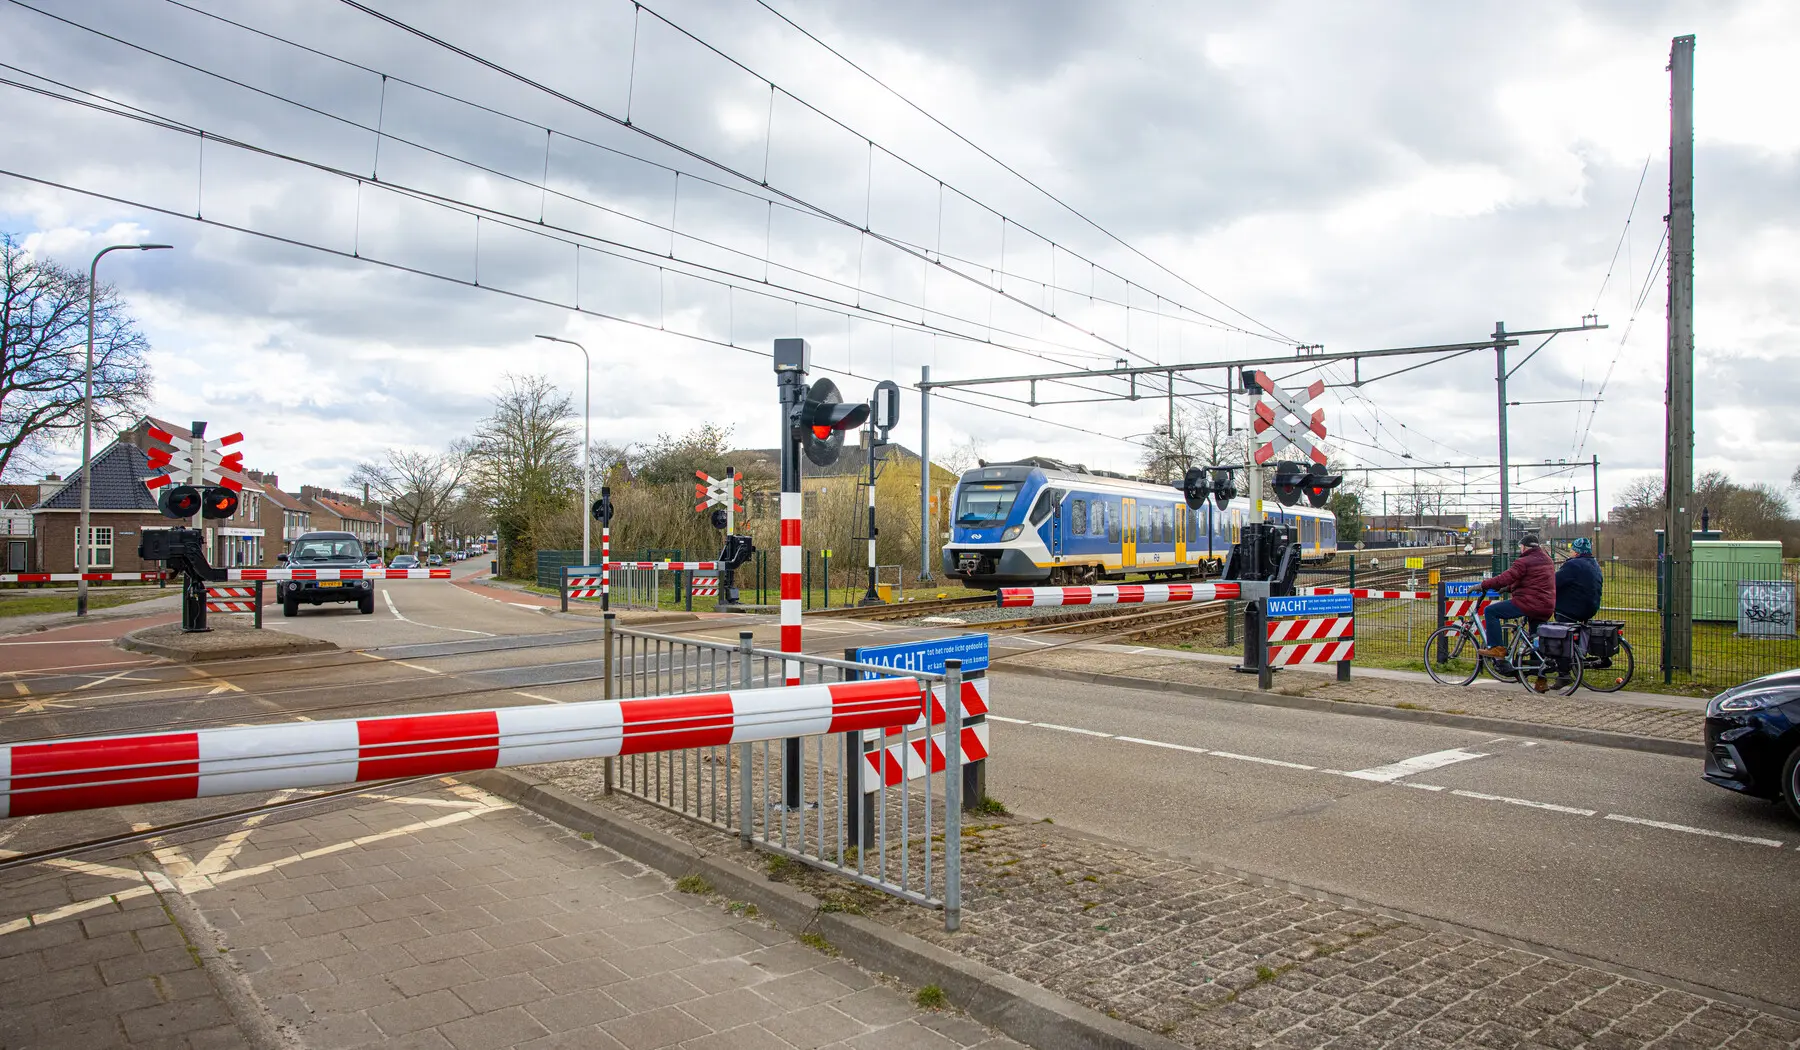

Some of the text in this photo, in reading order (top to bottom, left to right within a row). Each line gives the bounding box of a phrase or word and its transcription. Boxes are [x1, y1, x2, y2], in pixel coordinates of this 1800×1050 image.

[1270, 600, 1308, 612] WACHT
[966, 642, 983, 652] gedoofd
[862, 651, 926, 680] WACHT
